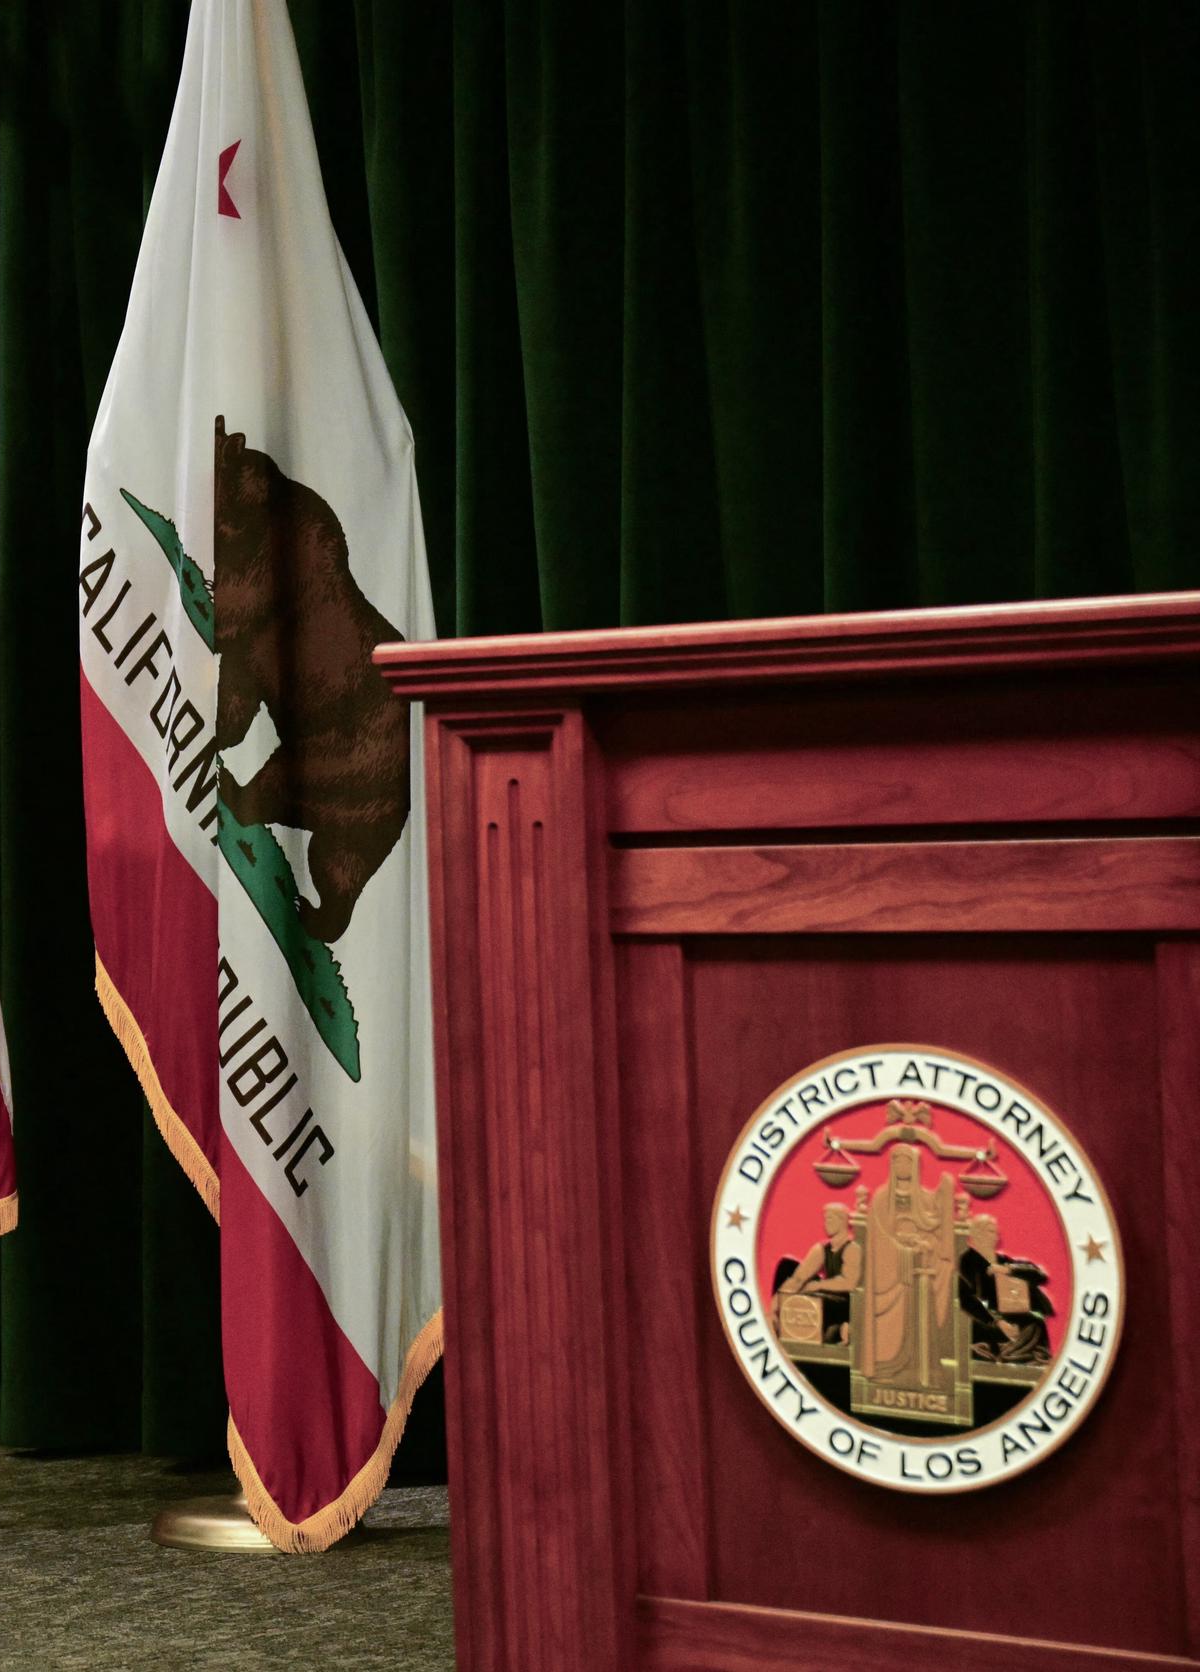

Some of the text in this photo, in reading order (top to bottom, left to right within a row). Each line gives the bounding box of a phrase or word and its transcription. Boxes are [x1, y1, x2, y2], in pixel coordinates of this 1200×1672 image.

[79, 502, 218, 846] ALIFORN
[218, 955, 335, 1199] UBLIC
[739, 1060, 1094, 1208] DISTRICT ATTORNEY
[723, 1256, 1110, 1482] COUNTY OF LOS ANGELES
[872, 1388, 947, 1412] JUSTICE
